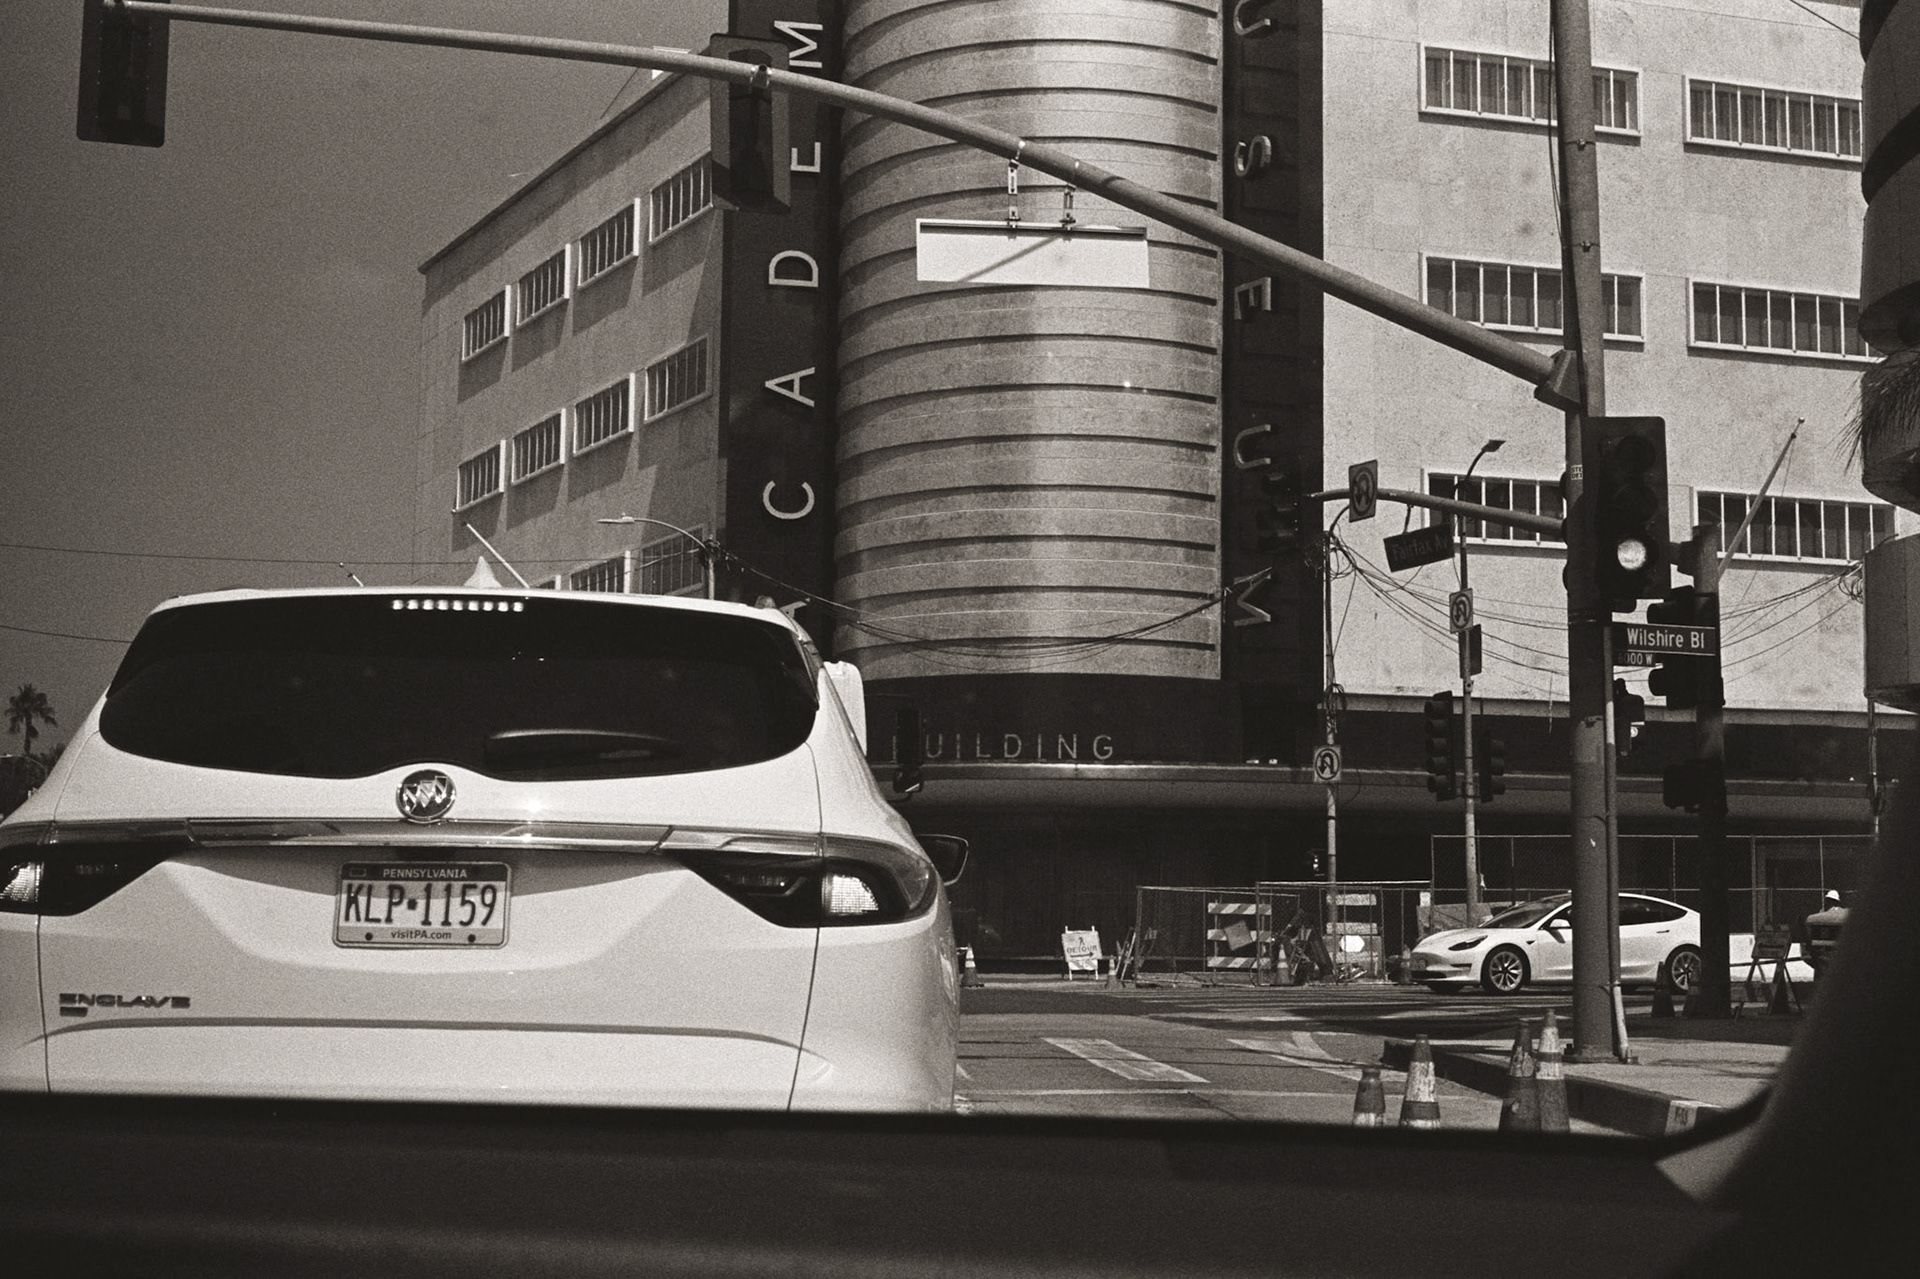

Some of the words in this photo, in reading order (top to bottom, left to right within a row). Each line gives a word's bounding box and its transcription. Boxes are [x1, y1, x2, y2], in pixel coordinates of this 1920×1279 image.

[1627, 628, 1684, 648] Wilshire
[1690, 631, 1705, 648] Bl
[1645, 653, 1653, 665] W
[893, 733, 1114, 762] UILDING
[382, 868, 468, 879] PENNSYLVANIA
[391, 930, 452, 940] visitPA.com
[1066, 945, 1098, 954] DETOUR
